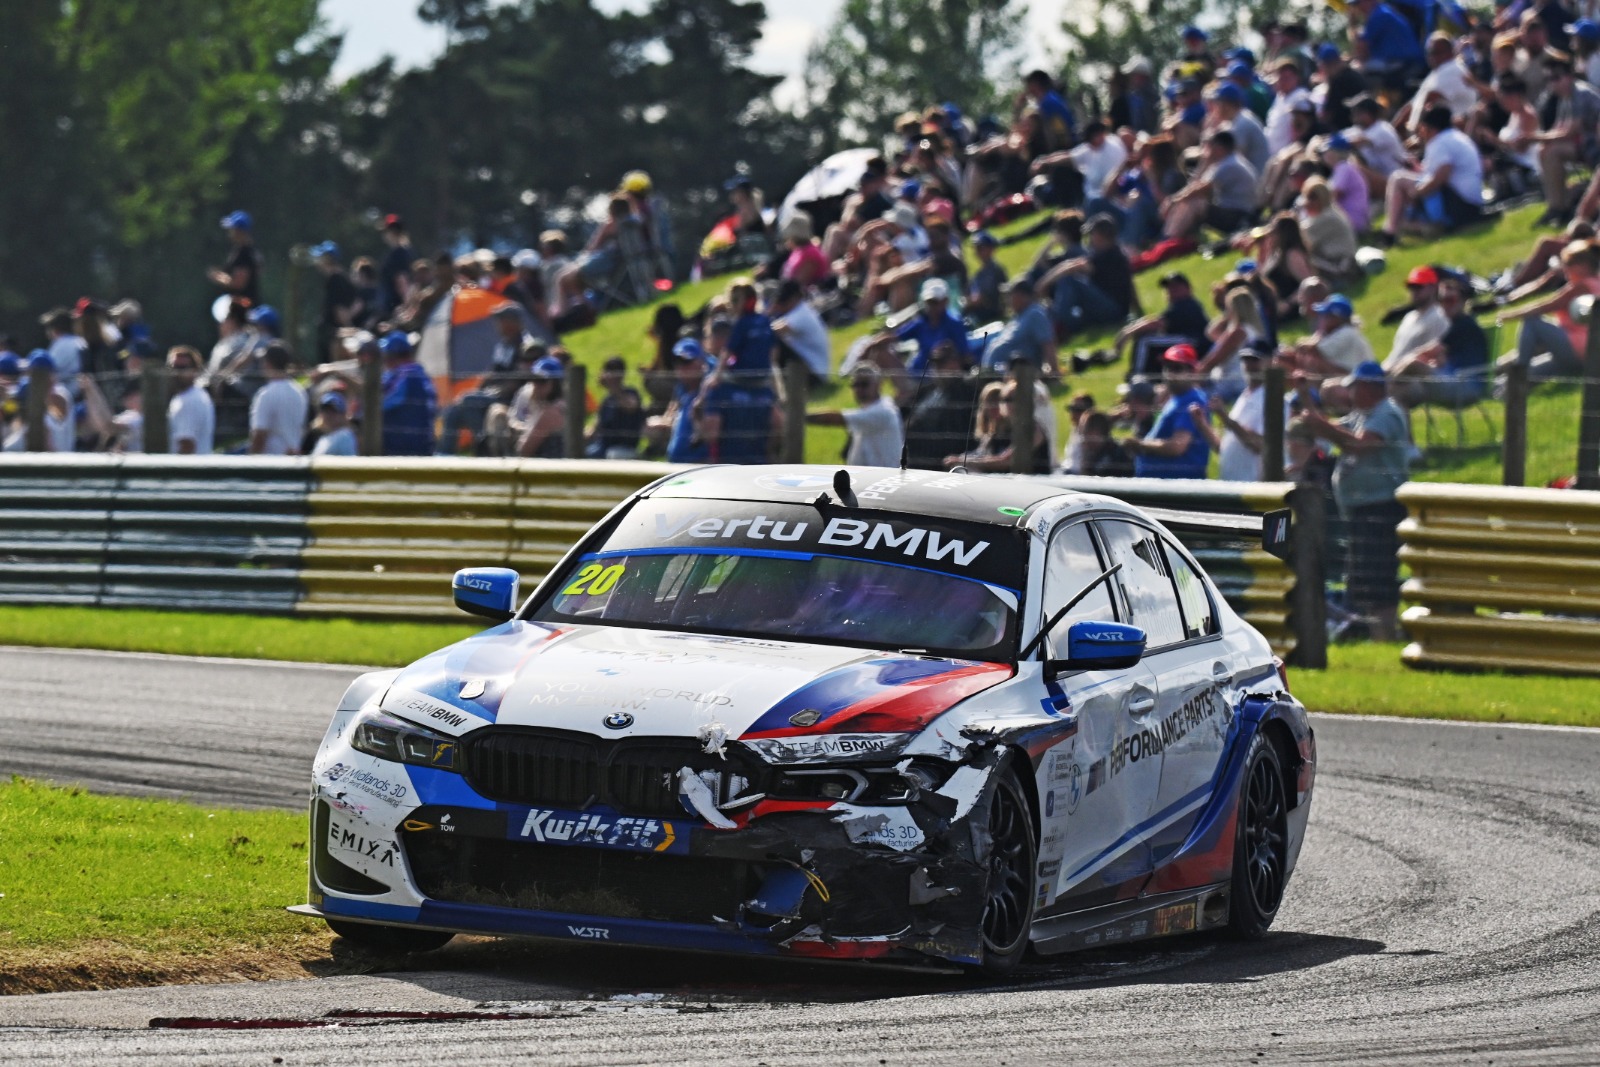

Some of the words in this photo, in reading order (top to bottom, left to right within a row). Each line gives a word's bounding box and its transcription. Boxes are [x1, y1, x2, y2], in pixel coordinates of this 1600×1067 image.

[655, 512, 808, 541] Vertu
[818, 517, 990, 566] BMW
[463, 576, 492, 591] WSR
[561, 564, 626, 596] 20
[1084, 631, 1124, 641] WSR
[395, 699, 467, 727] TEAMBMW
[346, 769, 390, 791] Midlands
[390, 783, 407, 798] 3D
[440, 824, 455, 832] TOW
[899, 825, 918, 838] 3D
[568, 925, 610, 939] WSR
